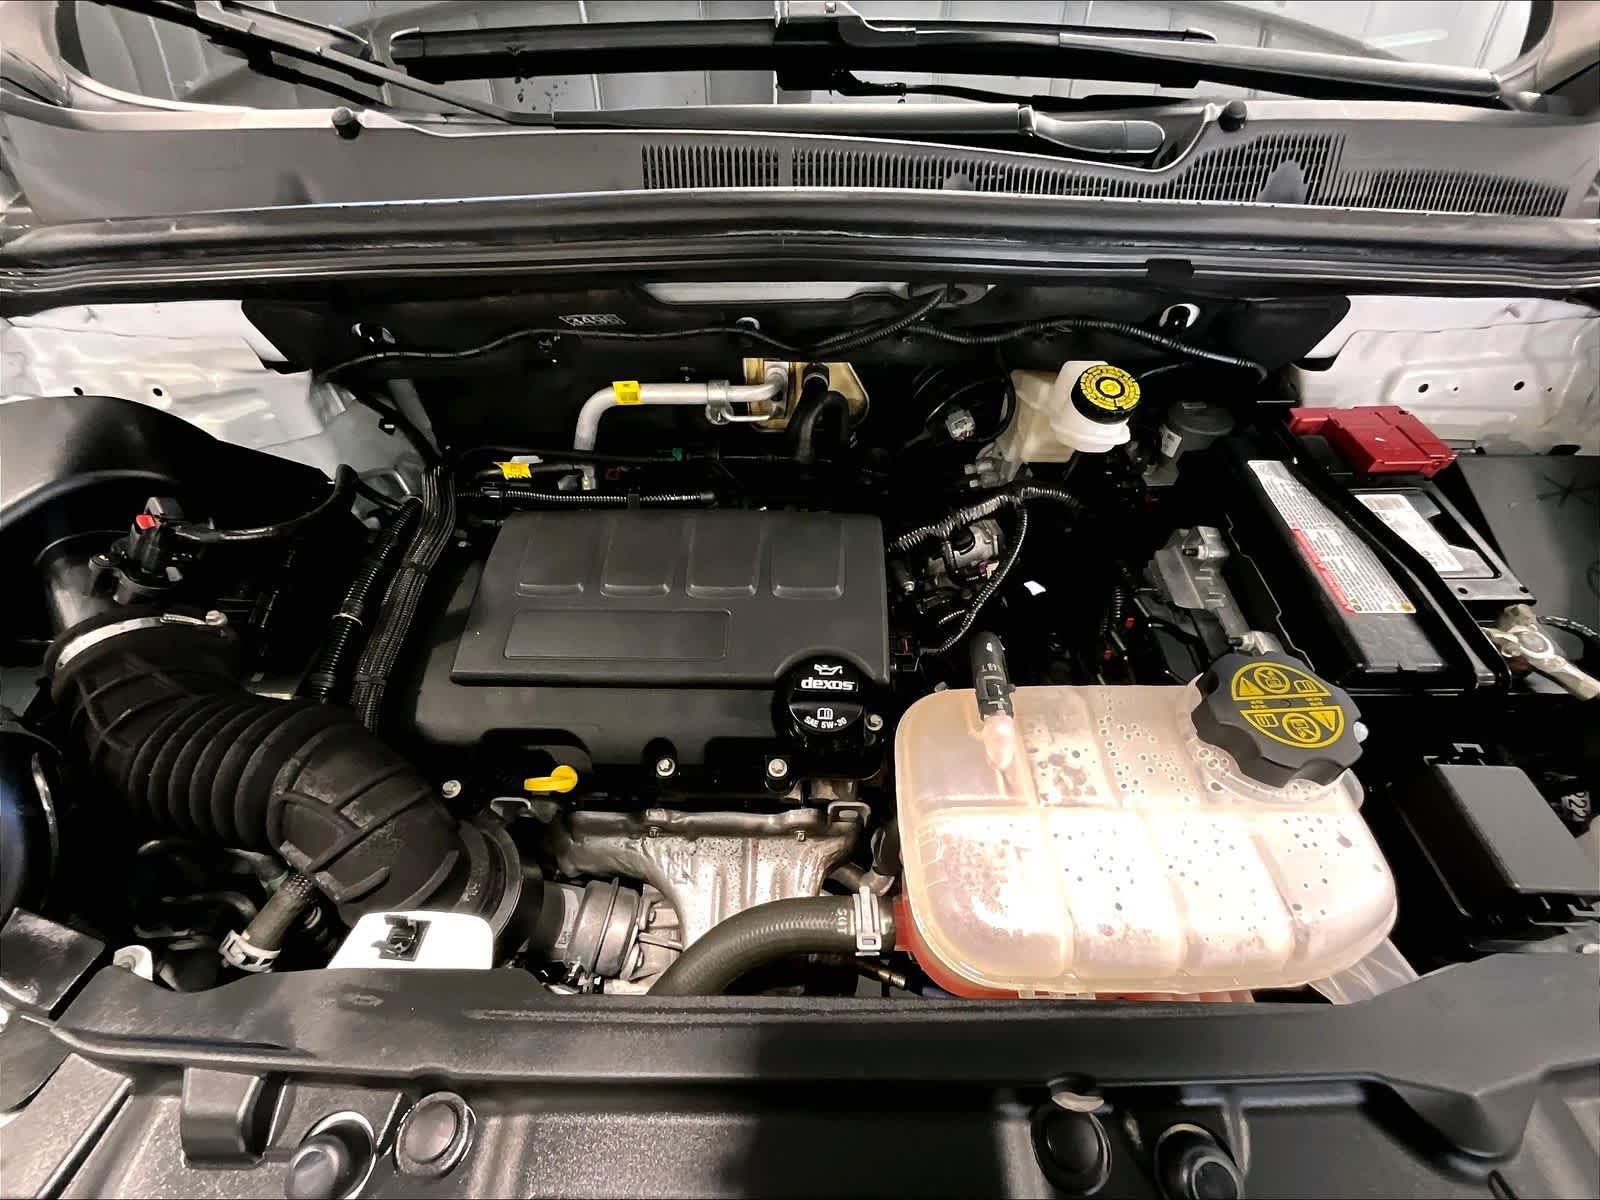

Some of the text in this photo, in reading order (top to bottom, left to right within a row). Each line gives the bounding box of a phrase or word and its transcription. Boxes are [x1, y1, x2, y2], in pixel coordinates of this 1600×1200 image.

[801, 677, 856, 691] dexos
[804, 716, 847, 729] SAE 5W-30
